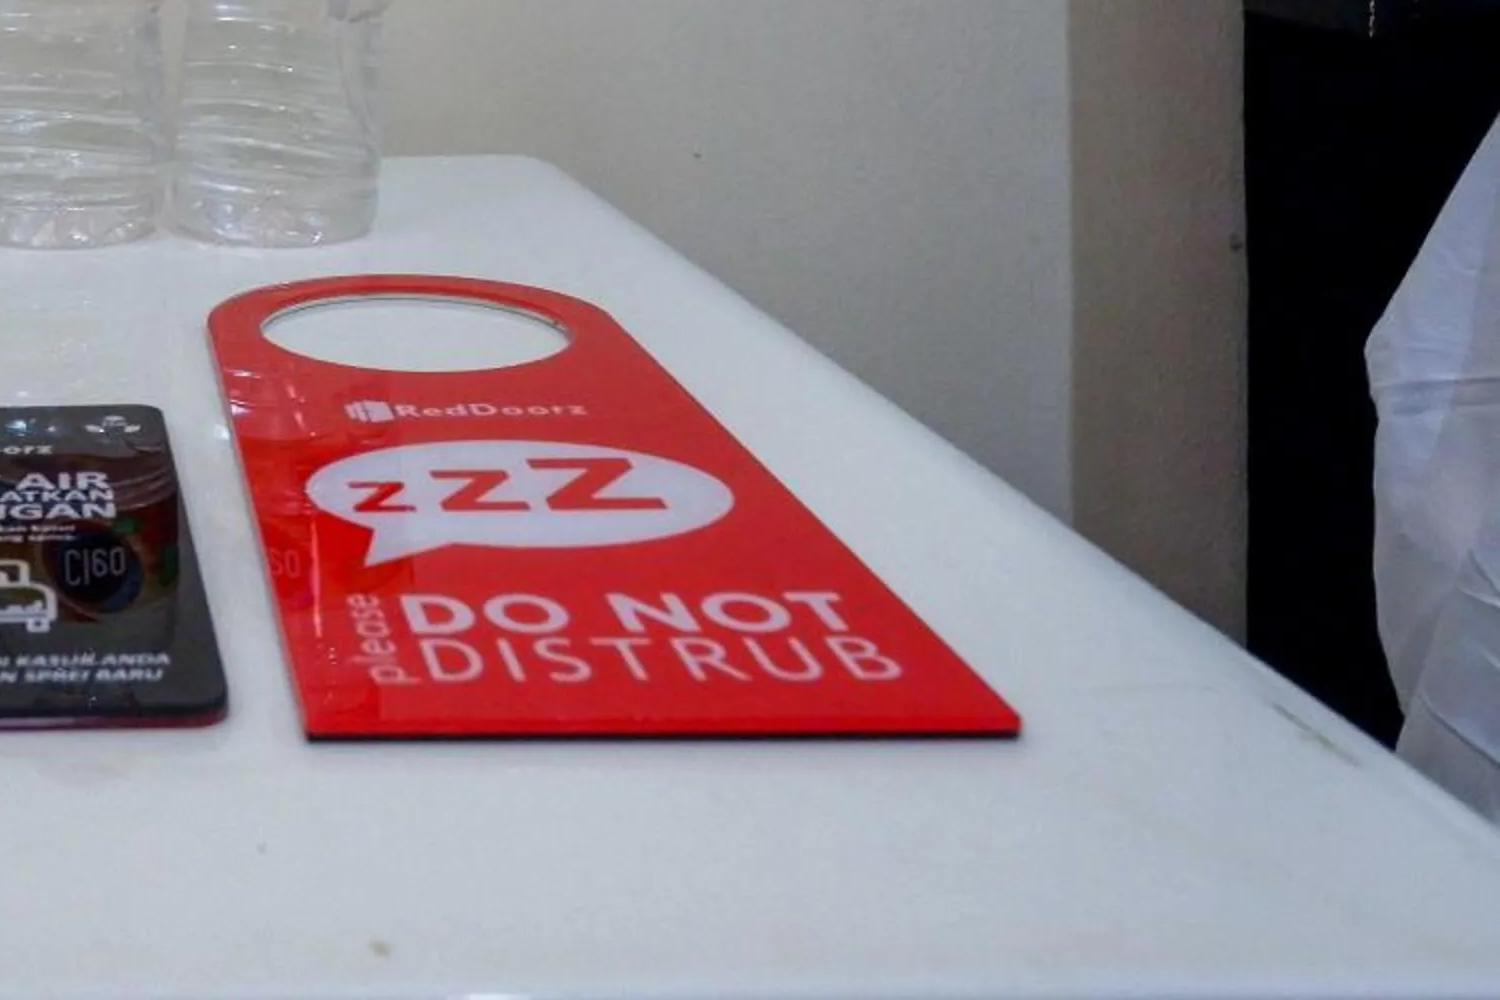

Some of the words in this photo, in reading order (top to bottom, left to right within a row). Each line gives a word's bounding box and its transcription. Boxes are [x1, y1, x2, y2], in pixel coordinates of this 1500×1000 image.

[394, 402, 589, 419] RedDoorz
[15, 471, 111, 491] AIR
[400, 592, 571, 634] DO
[605, 592, 850, 634] NOT
[347, 593, 423, 685] please
[100, 651, 171, 666] ANDA
[418, 636, 904, 682] DISTRUB
